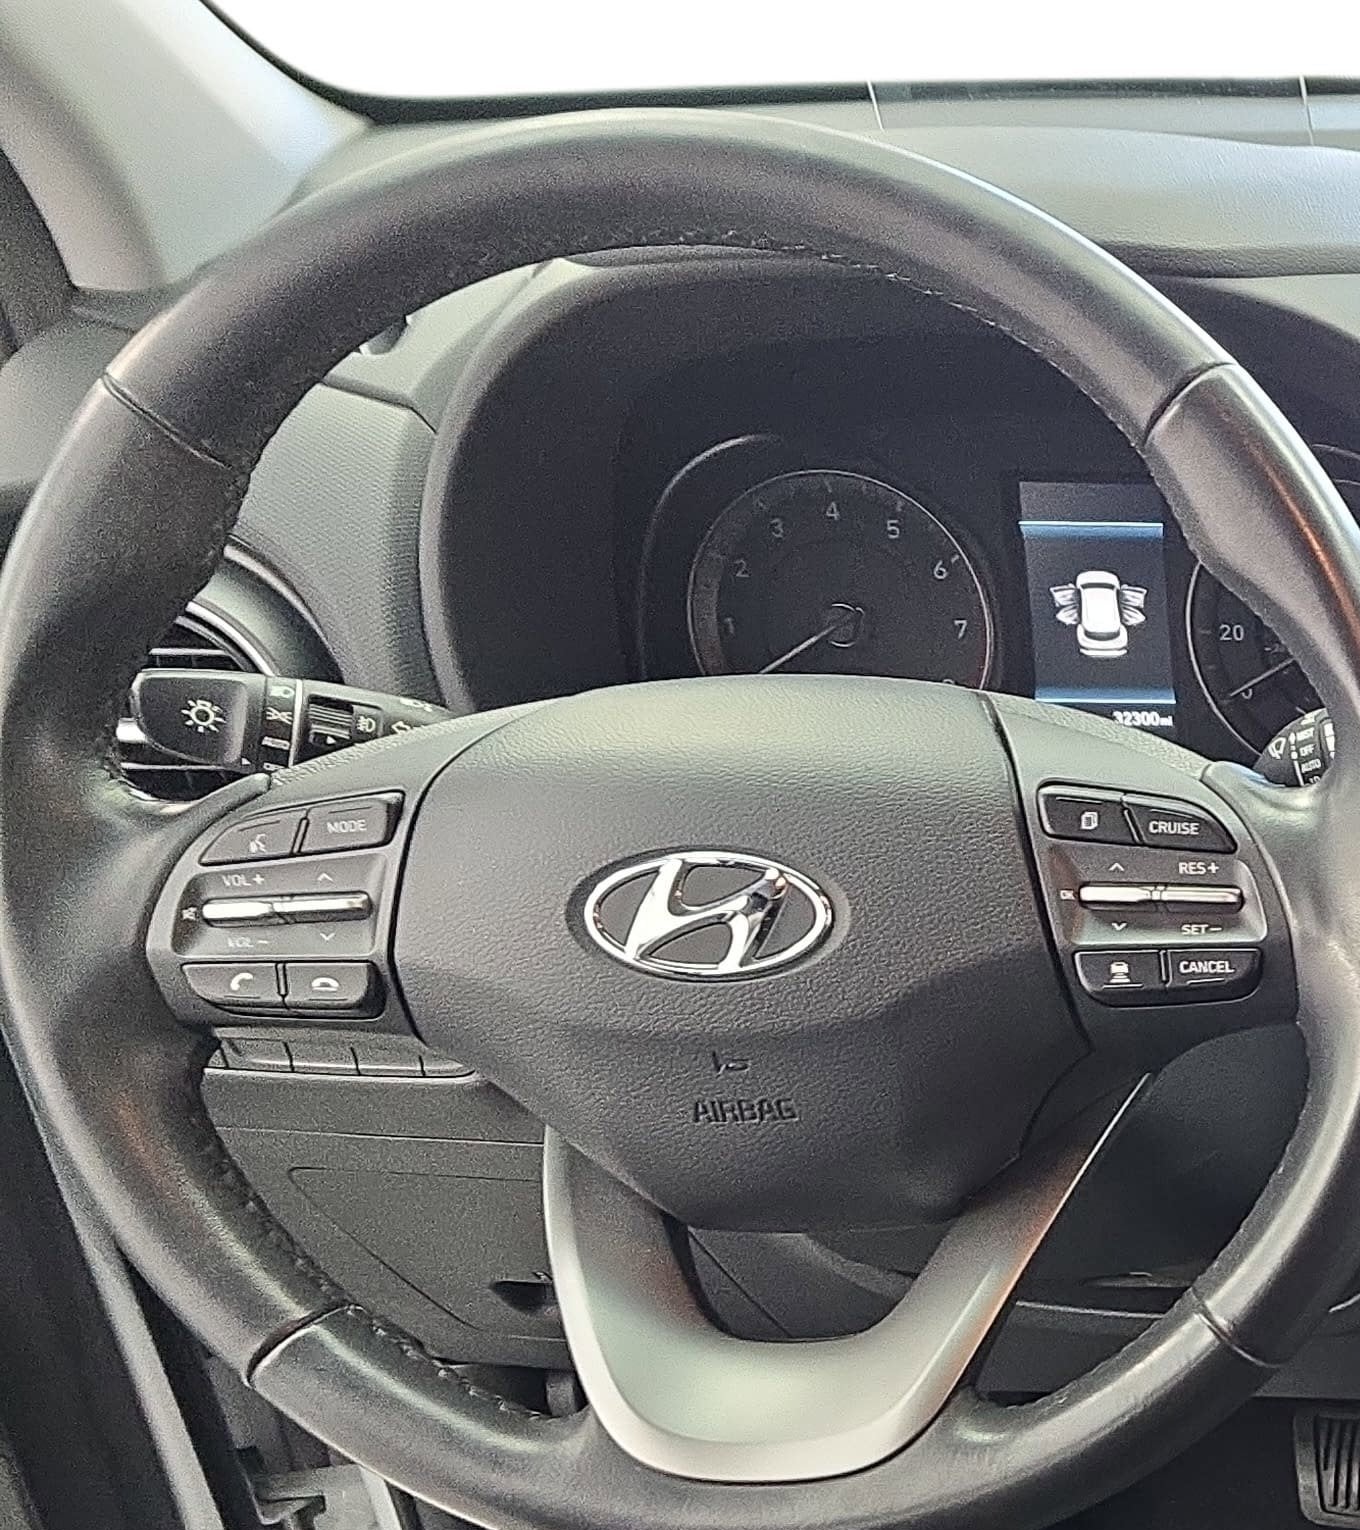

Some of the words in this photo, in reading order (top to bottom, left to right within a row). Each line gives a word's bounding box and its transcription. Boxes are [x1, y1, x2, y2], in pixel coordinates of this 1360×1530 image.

[825, 501, 841, 521] 4
[770, 519, 784, 539] 3
[886, 519, 900, 539] 5
[733, 558, 750, 579] 2
[933, 559, 949, 580] 6
[724, 617, 736, 636] 1
[953, 618, 969, 640] 7
[1219, 624, 1246, 641] 20
[326, 819, 368, 835] MODE
[1149, 821, 1200, 835] CRUISE
[1179, 961, 1235, 974] CANCEL
[693, 1098, 799, 1123] AIRBAG
